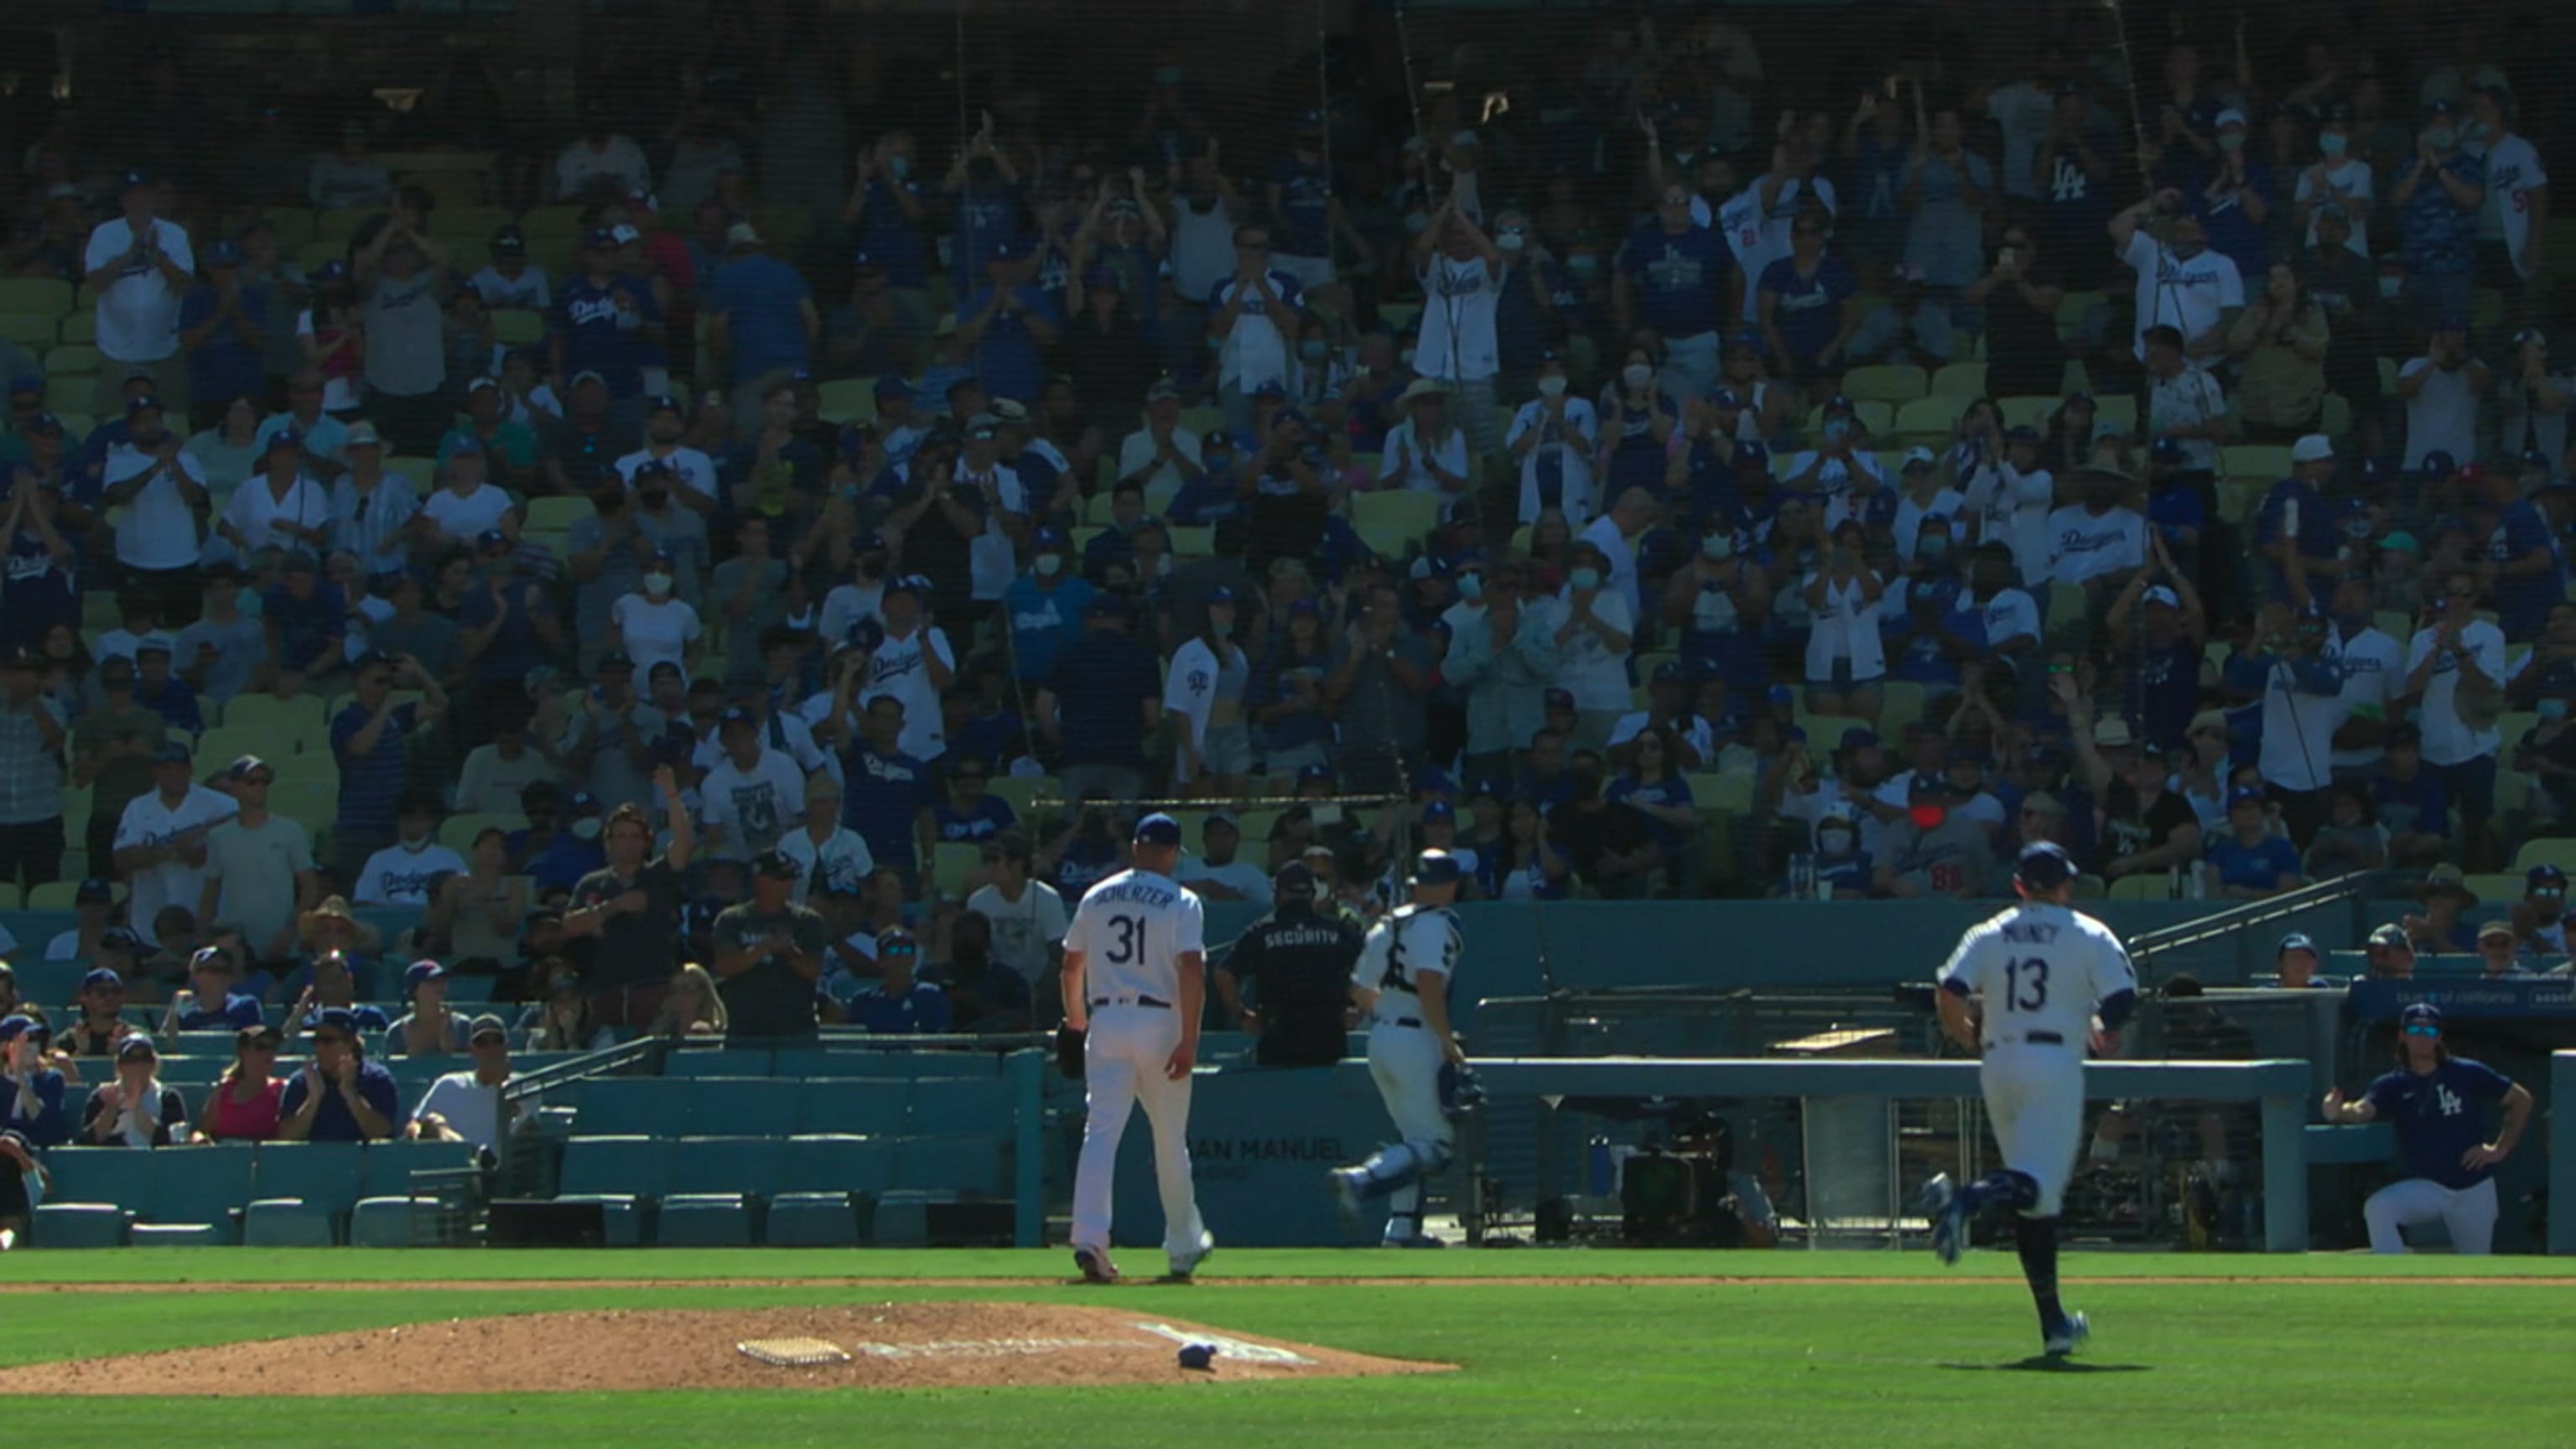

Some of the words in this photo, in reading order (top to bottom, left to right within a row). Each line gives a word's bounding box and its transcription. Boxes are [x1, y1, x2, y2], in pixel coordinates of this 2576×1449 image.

[2051, 155, 2086, 202] LA
[1105, 914, 1145, 965] 31
[2004, 956, 2049, 1013] 13
[2435, 1083, 2463, 1116] LA
[1190, 1138, 1233, 1160] AN
[1240, 1138, 1350, 1161] MANUEL
